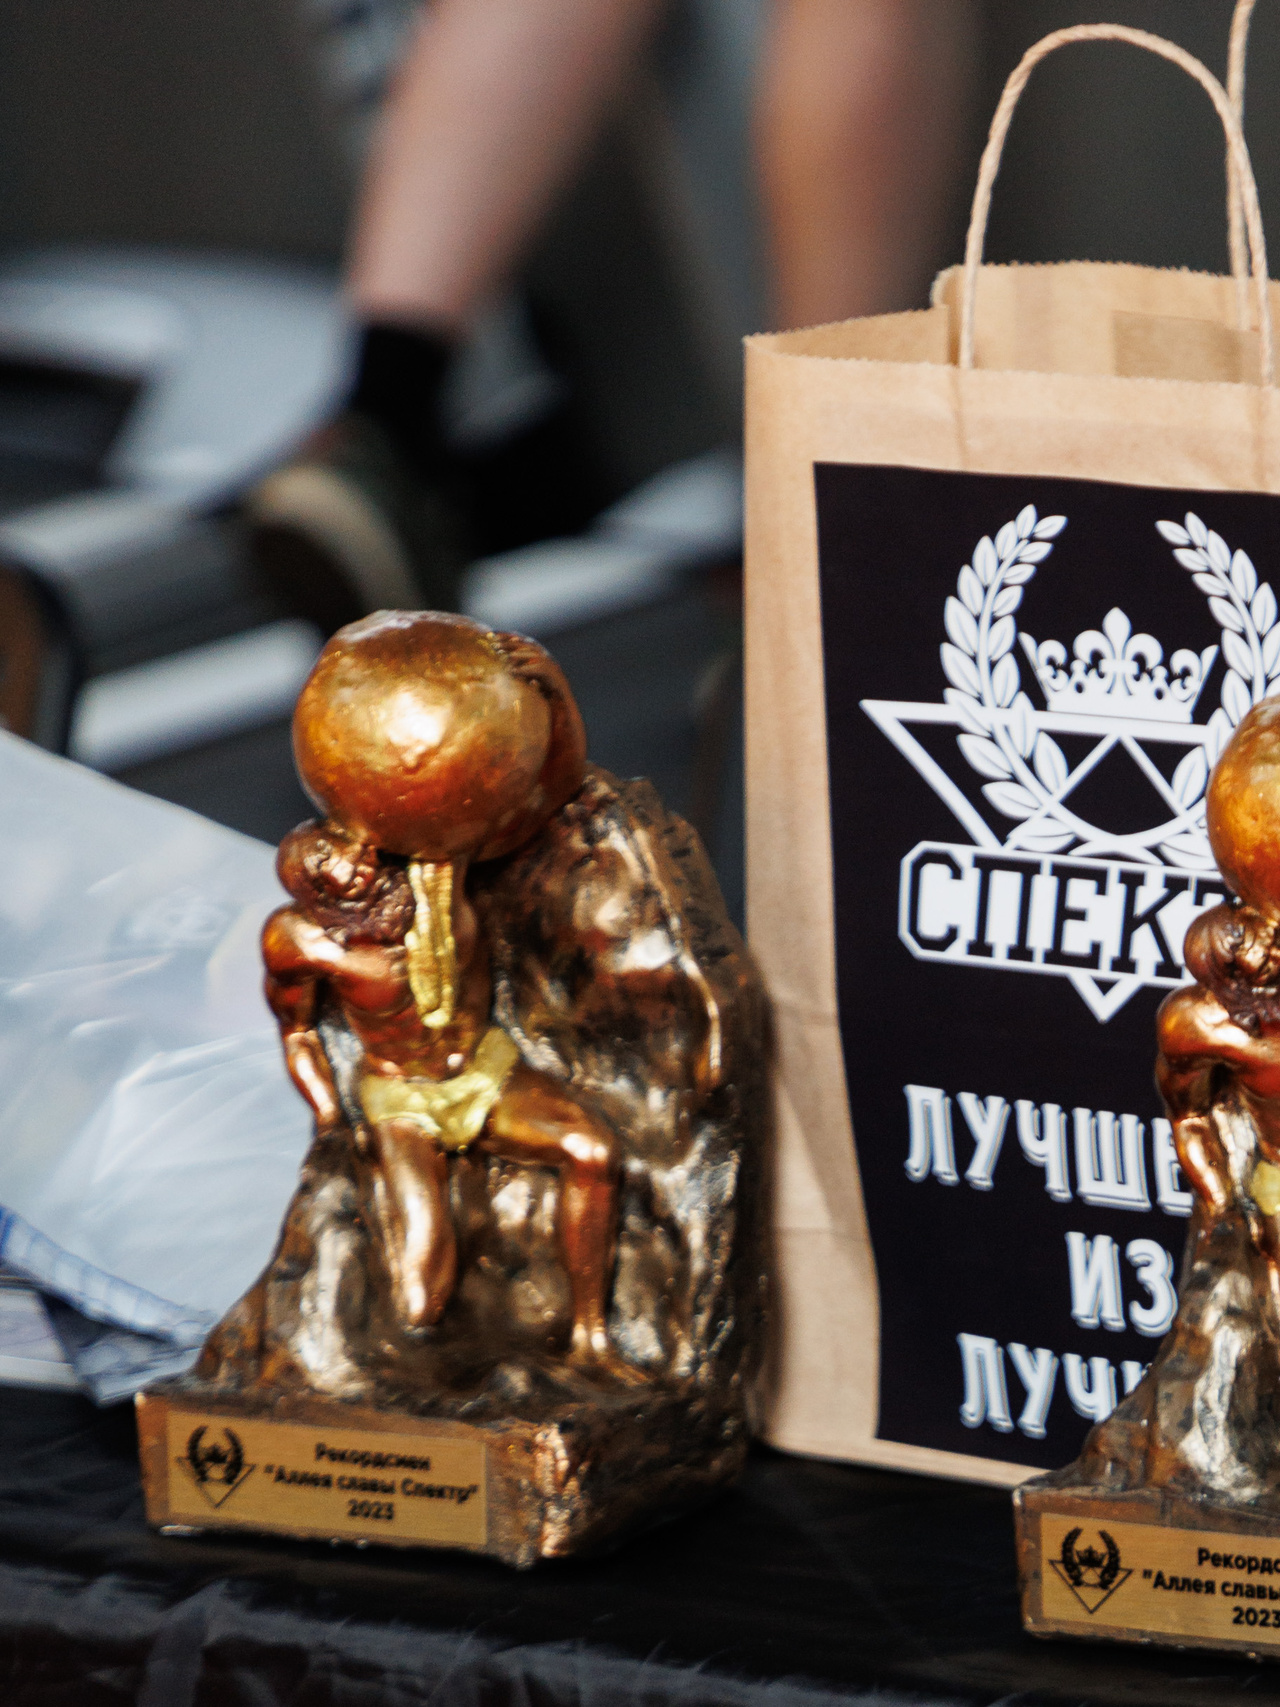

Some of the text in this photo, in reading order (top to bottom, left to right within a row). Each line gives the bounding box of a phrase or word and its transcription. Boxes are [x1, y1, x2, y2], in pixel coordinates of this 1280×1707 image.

[906, 848, 1236, 979] СПЕК
[904, 1084, 1194, 1216] ЛУЧШЕ
[1066, 1231, 1178, 1337] ИЗ
[957, 1333, 1153, 1439] ЛУЧ
[315, 1442, 431, 1471] Рекордсмен
[337, 1475, 395, 1494] славы
[349, 1500, 395, 1520] 2023
